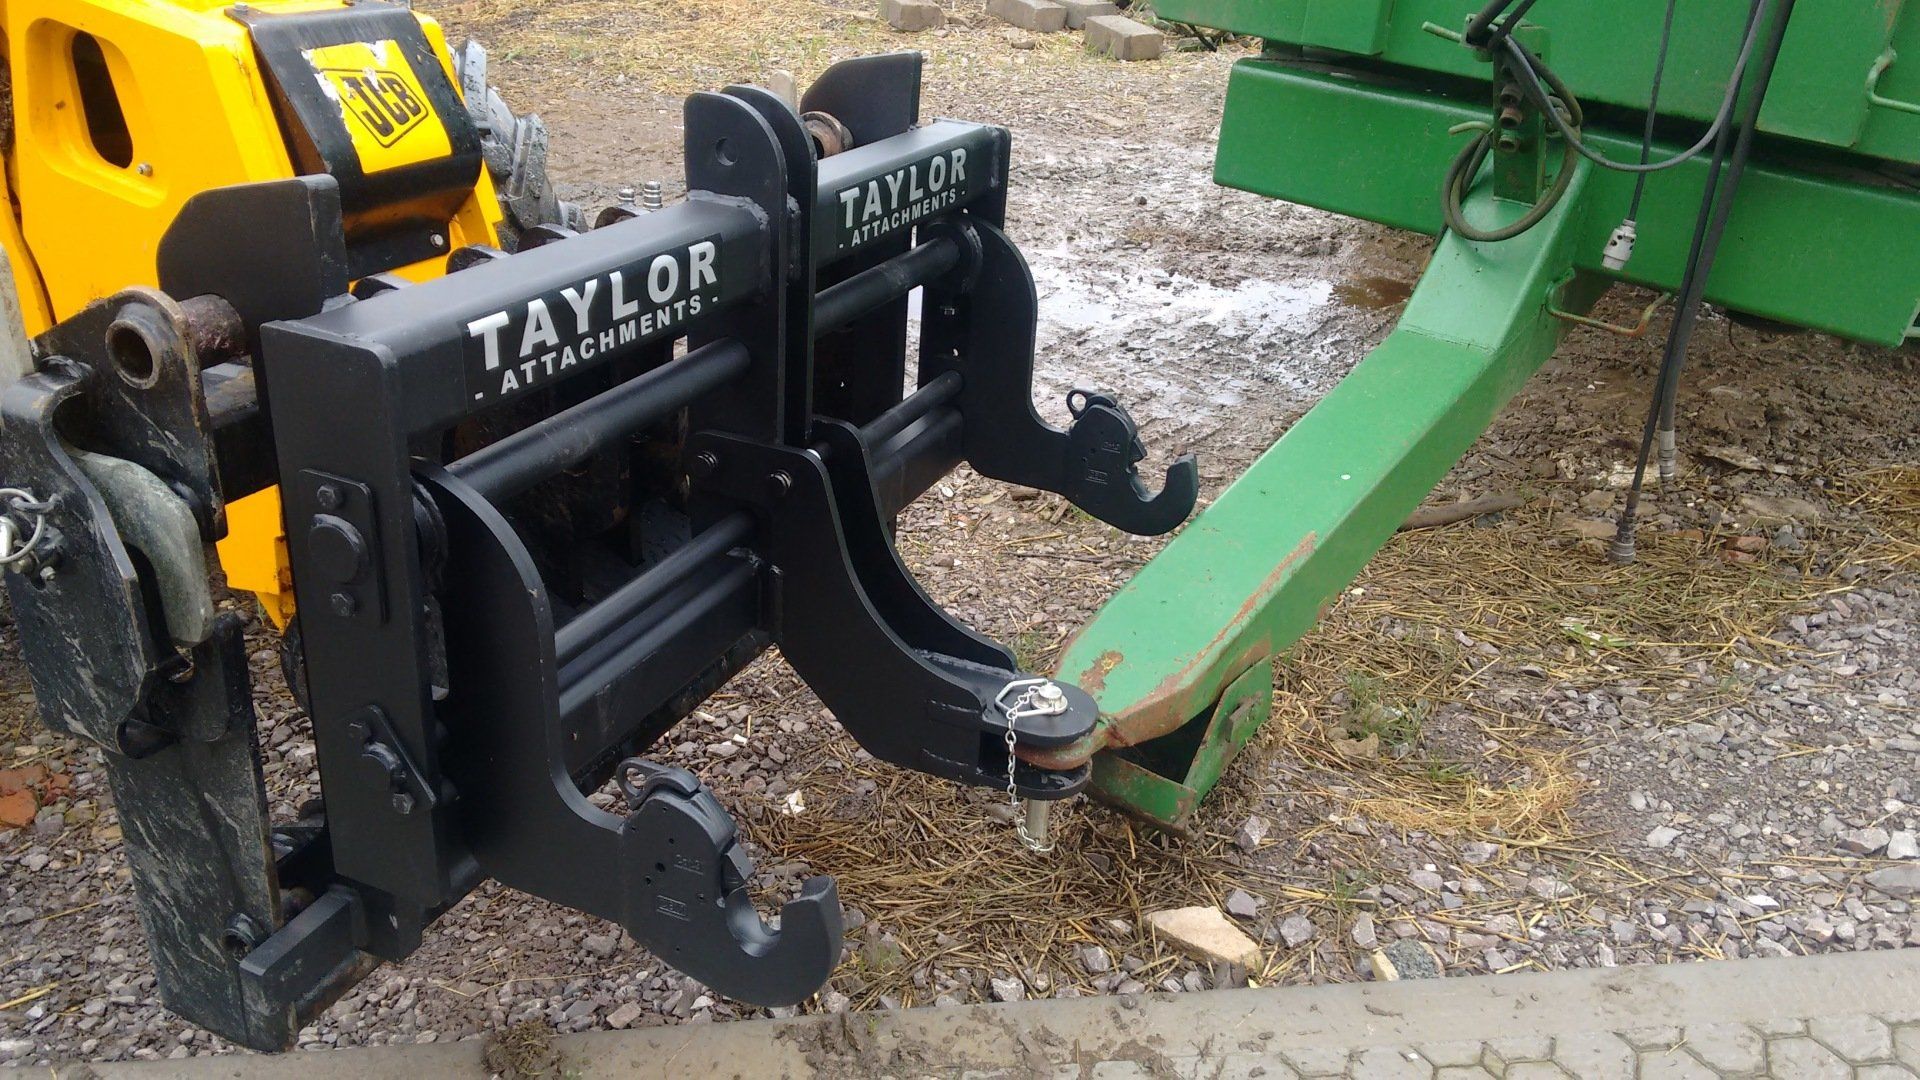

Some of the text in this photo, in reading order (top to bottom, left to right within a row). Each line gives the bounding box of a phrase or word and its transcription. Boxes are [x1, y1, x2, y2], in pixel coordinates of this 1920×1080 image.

[340, 76, 421, 137] JCB
[839, 148, 967, 229] TAYLOR
[851, 188, 956, 247] ATTACHMENTS
[467, 241, 718, 371] TAYLOR
[501, 295, 701, 395] ATTACHMENTS
